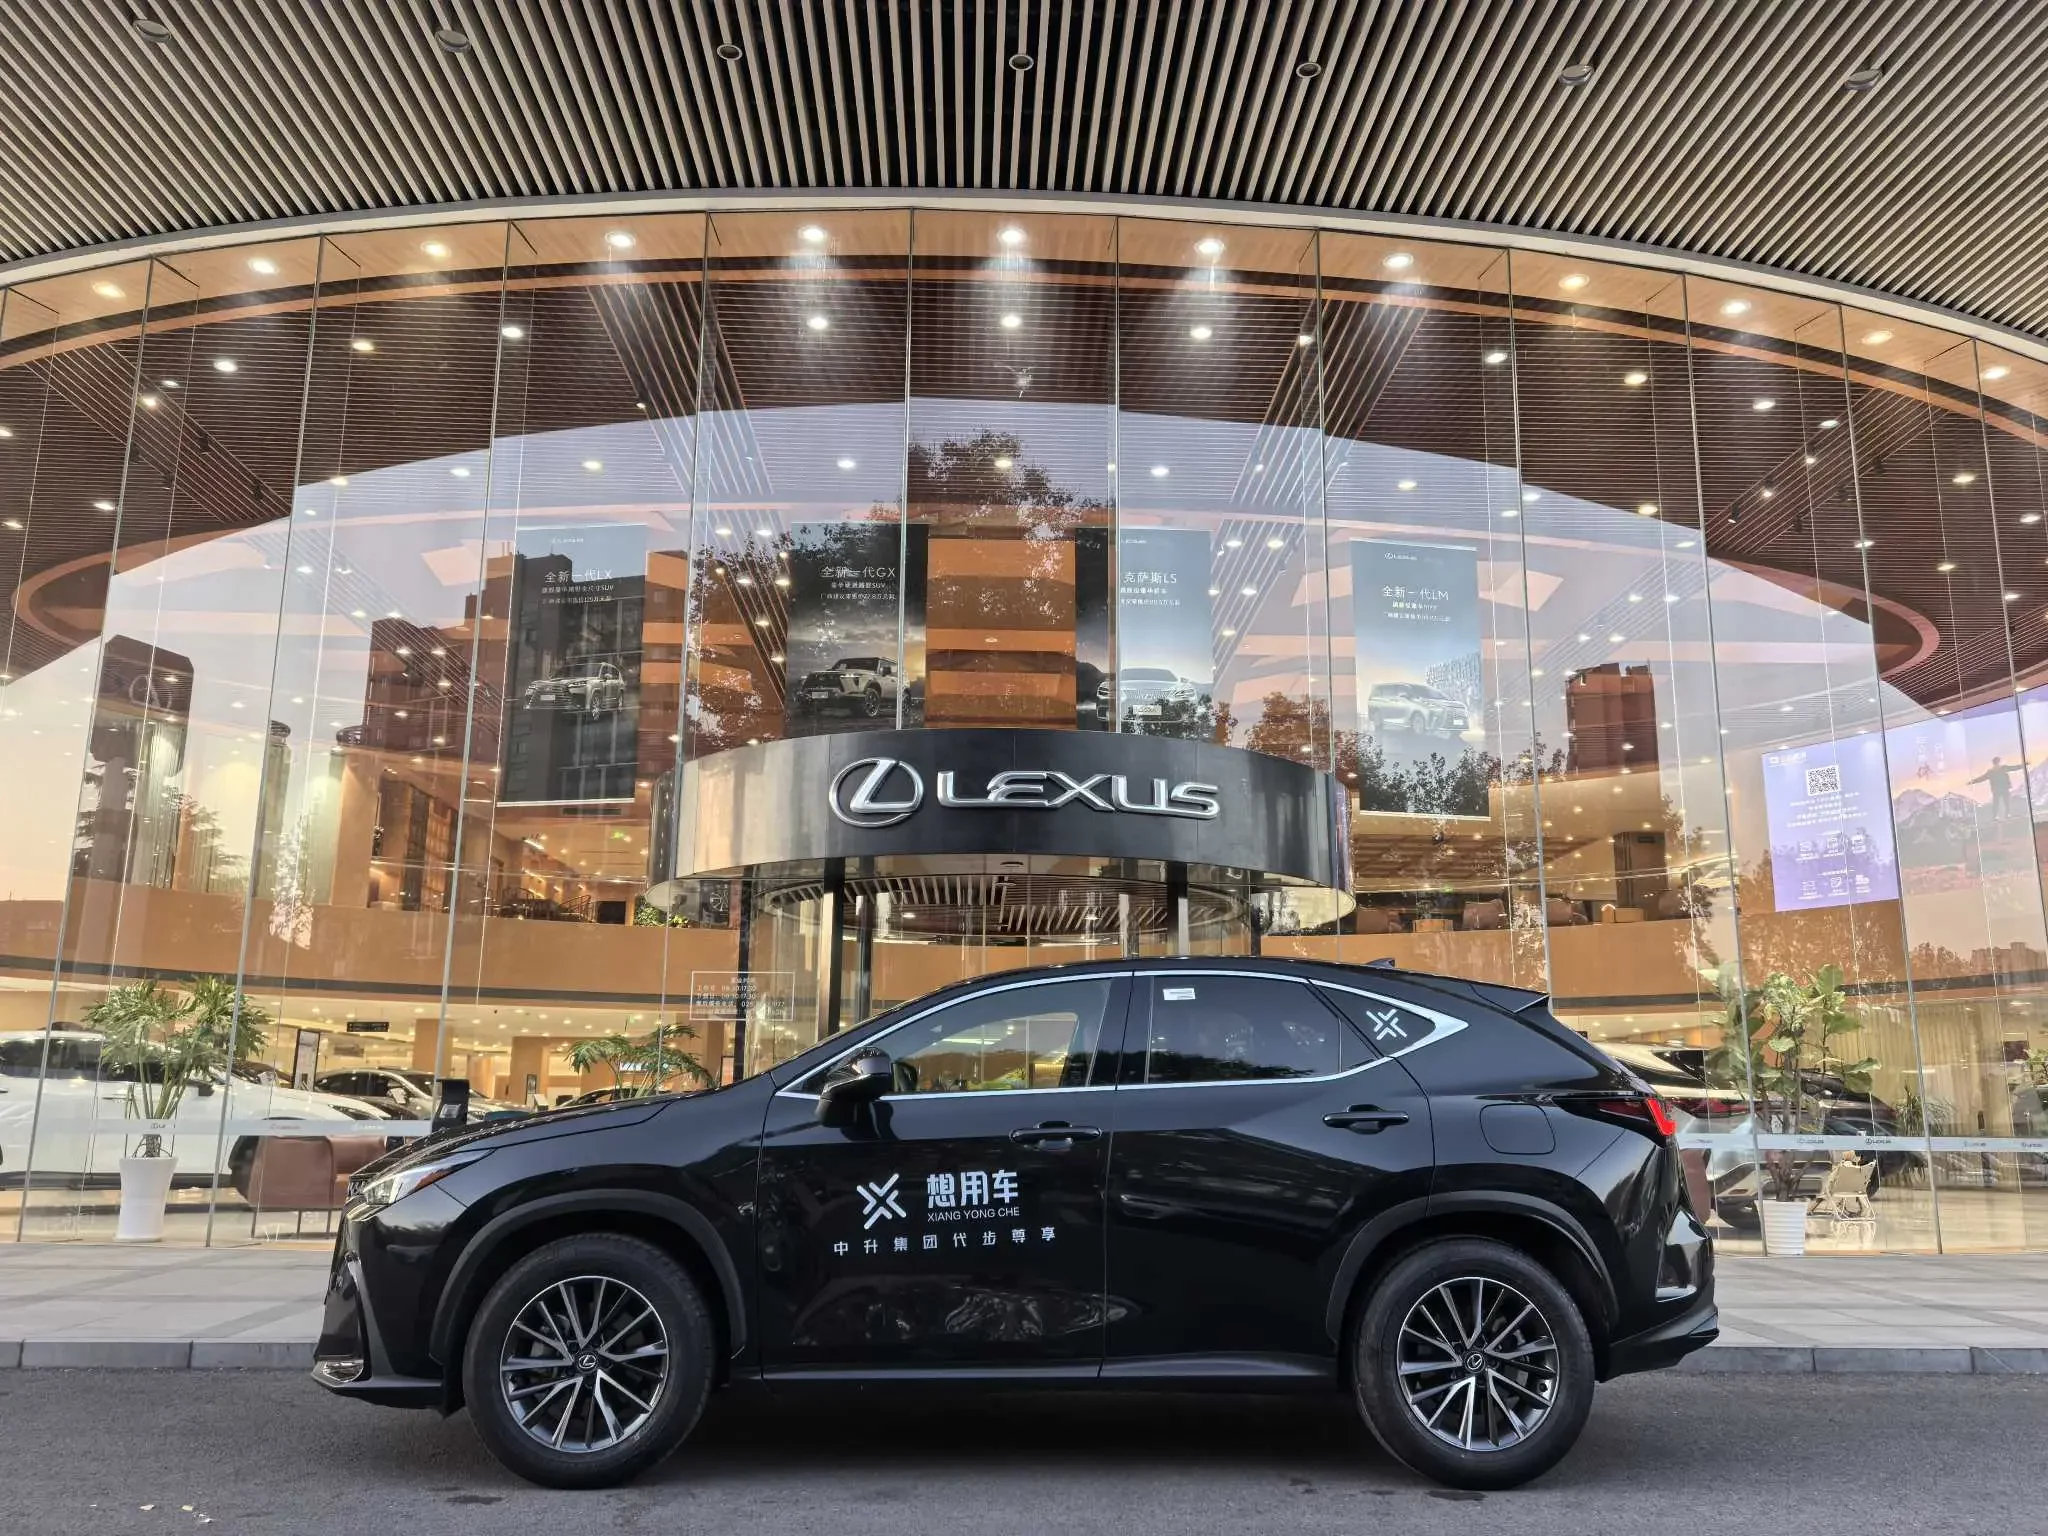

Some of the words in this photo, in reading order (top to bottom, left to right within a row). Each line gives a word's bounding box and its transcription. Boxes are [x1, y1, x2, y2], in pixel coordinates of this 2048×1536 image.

[543, 568, 612, 583] 全新一代LX
[820, 566, 896, 579] 全新一代GX
[1123, 571, 1177, 584] 克萨斯LS
[1382, 584, 1449, 601] 全新一代LM
[937, 771, 1219, 820] LEXUS
[927, 1169, 1019, 1209] 想用车
[927, 1211, 961, 1223] XIANG
[963, 1208, 995, 1220] YONG
[998, 1207, 1020, 1218] CHE
[833, 1226, 1056, 1256] 中升集团代步尊享
